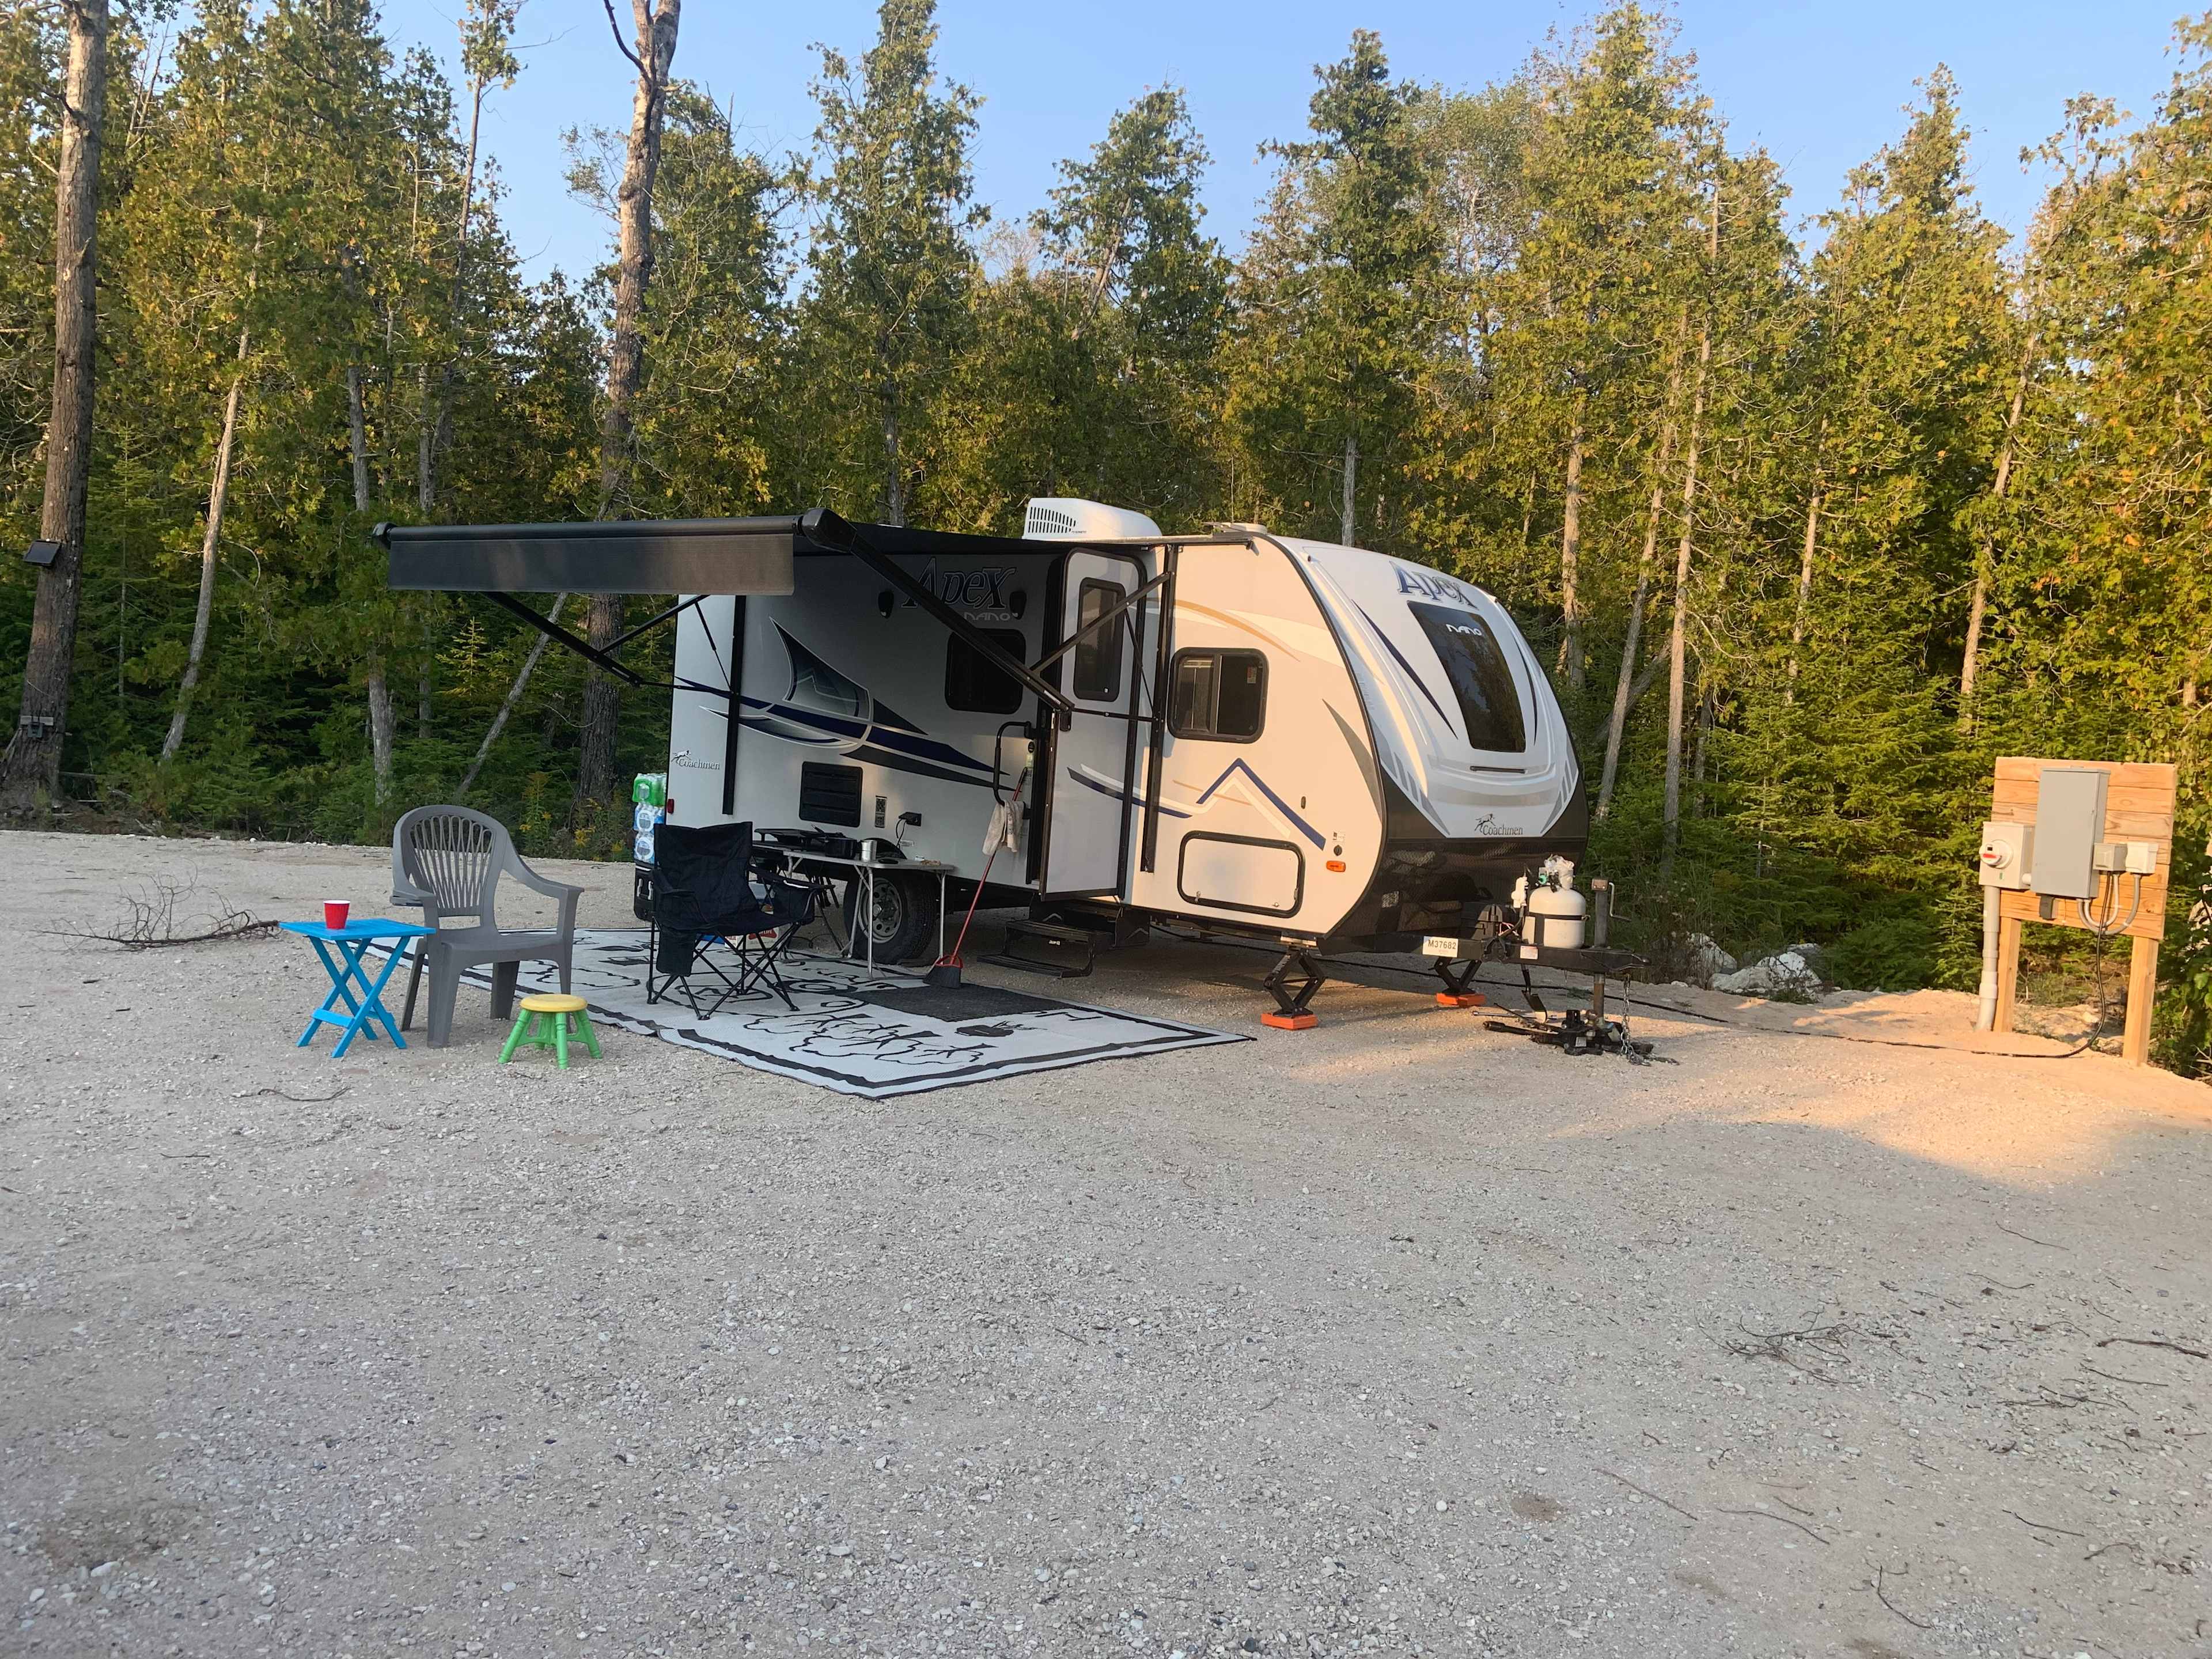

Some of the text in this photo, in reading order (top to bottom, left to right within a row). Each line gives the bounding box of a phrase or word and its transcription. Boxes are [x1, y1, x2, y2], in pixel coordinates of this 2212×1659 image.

[679, 758, 720, 770] Coachmen
[1483, 824, 1524, 835] Coachmen
[1427, 939, 1457, 950] M37682
